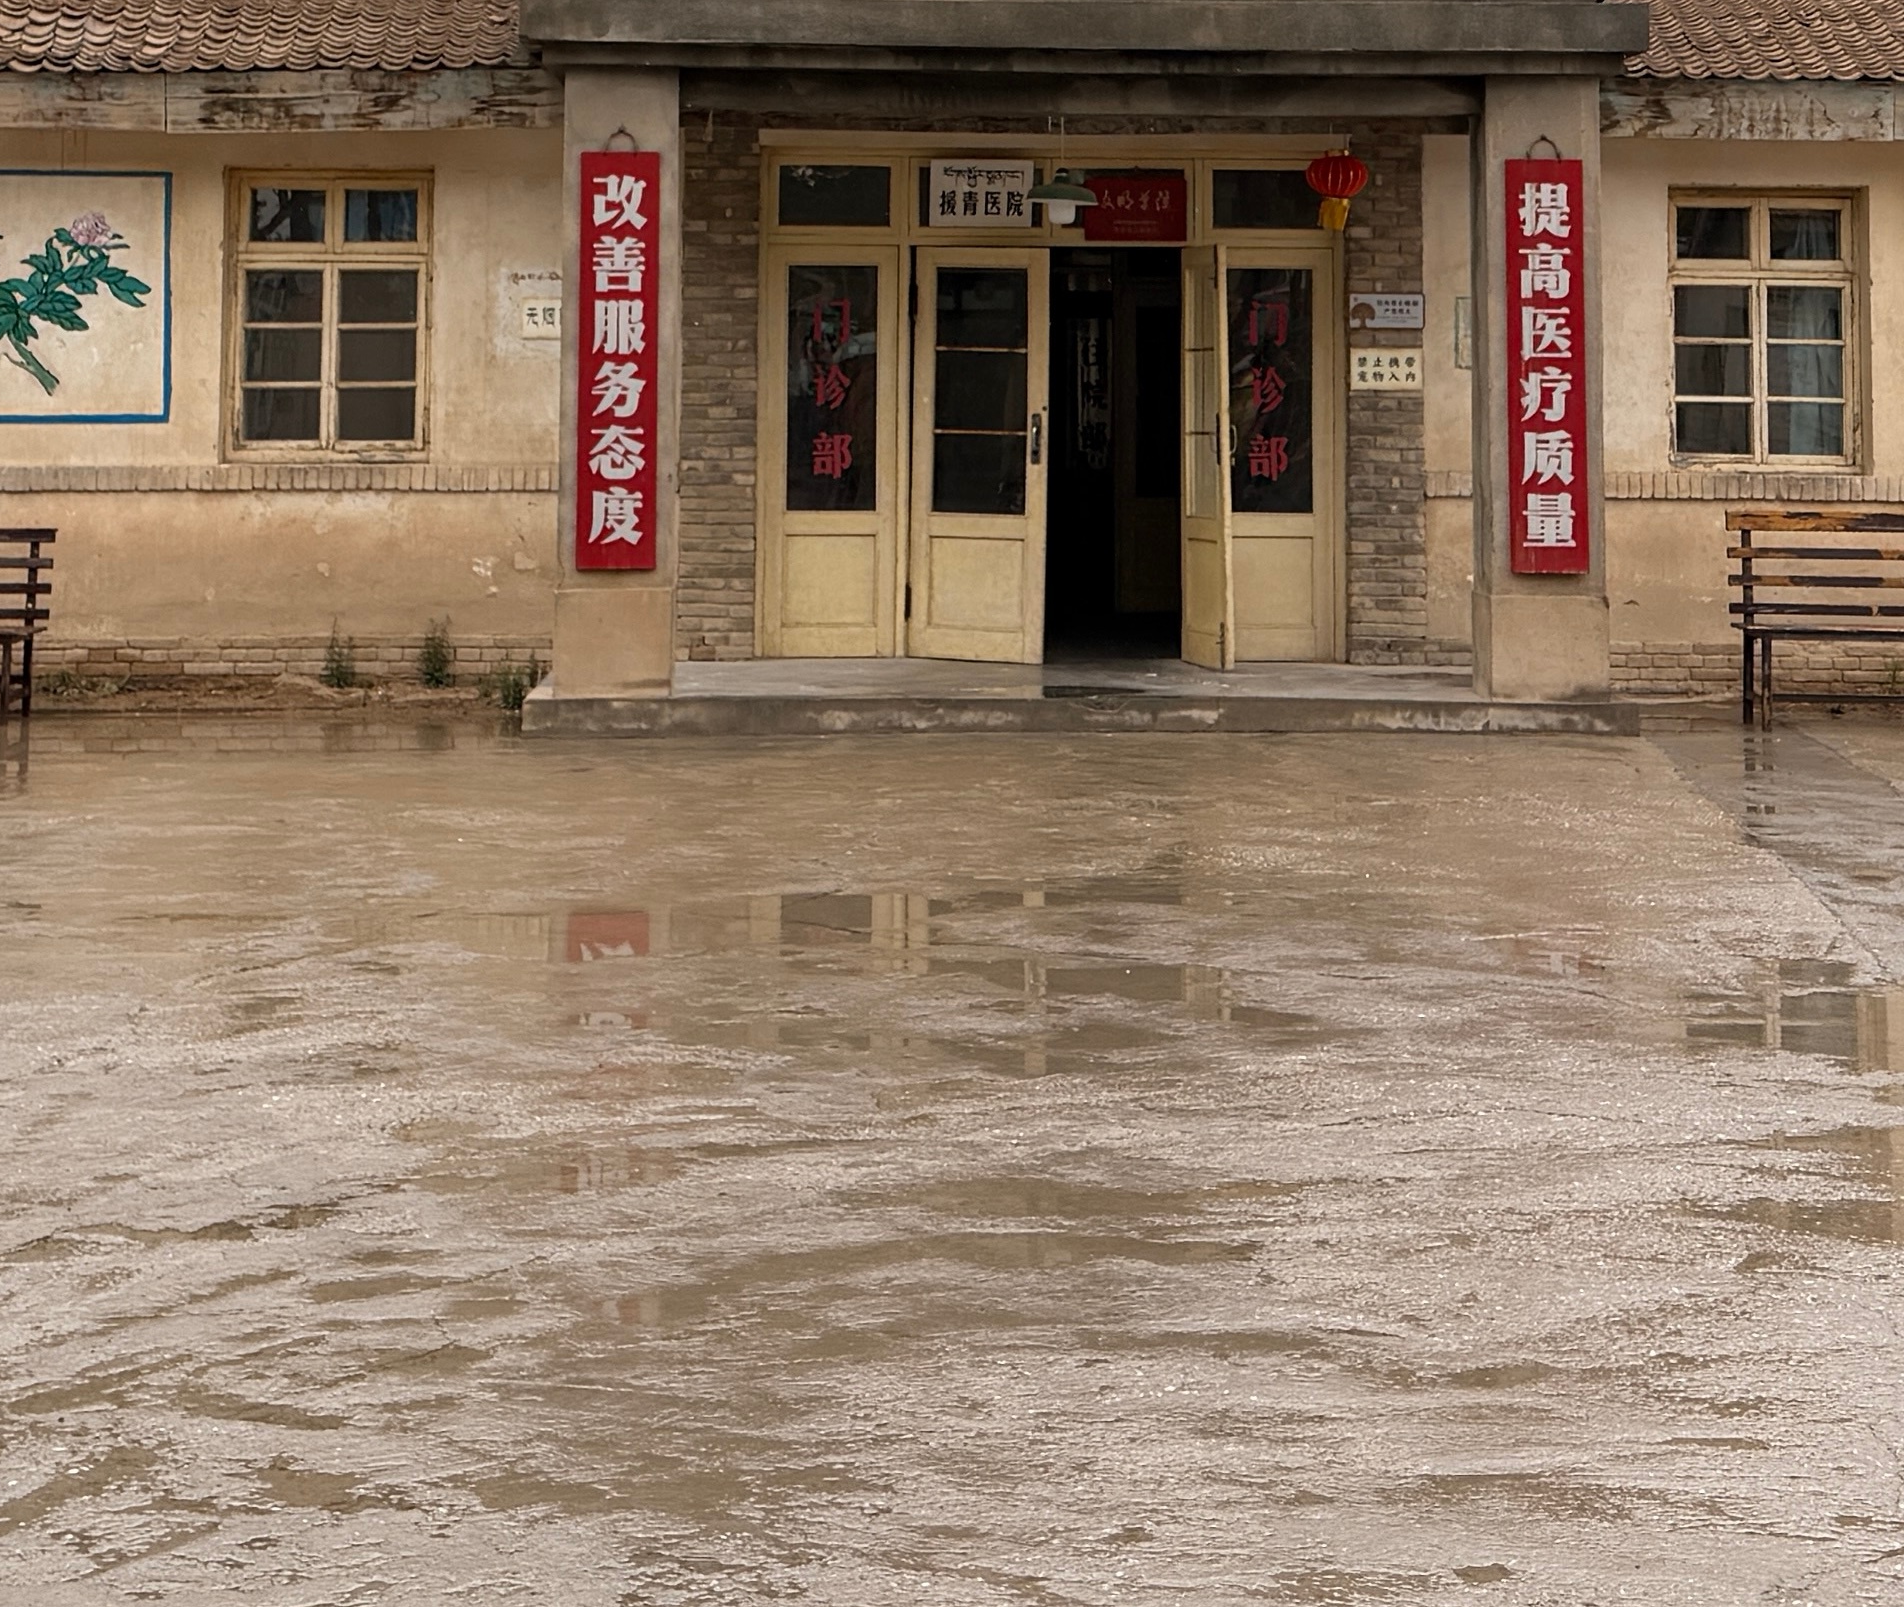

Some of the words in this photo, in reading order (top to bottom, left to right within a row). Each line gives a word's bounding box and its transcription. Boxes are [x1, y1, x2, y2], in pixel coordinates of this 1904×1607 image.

[939, 190, 1024, 217] 援青医院
[588, 174, 649, 546] 改善服务态度
[812, 298, 854, 480] 门诊部
[1248, 300, 1289, 482] 门诊部
[1357, 356, 1416, 369] 禁止携带
[1357, 370, 1416, 383] 宠物入内
[1519, 182, 1576, 548] 提高医疗质量
